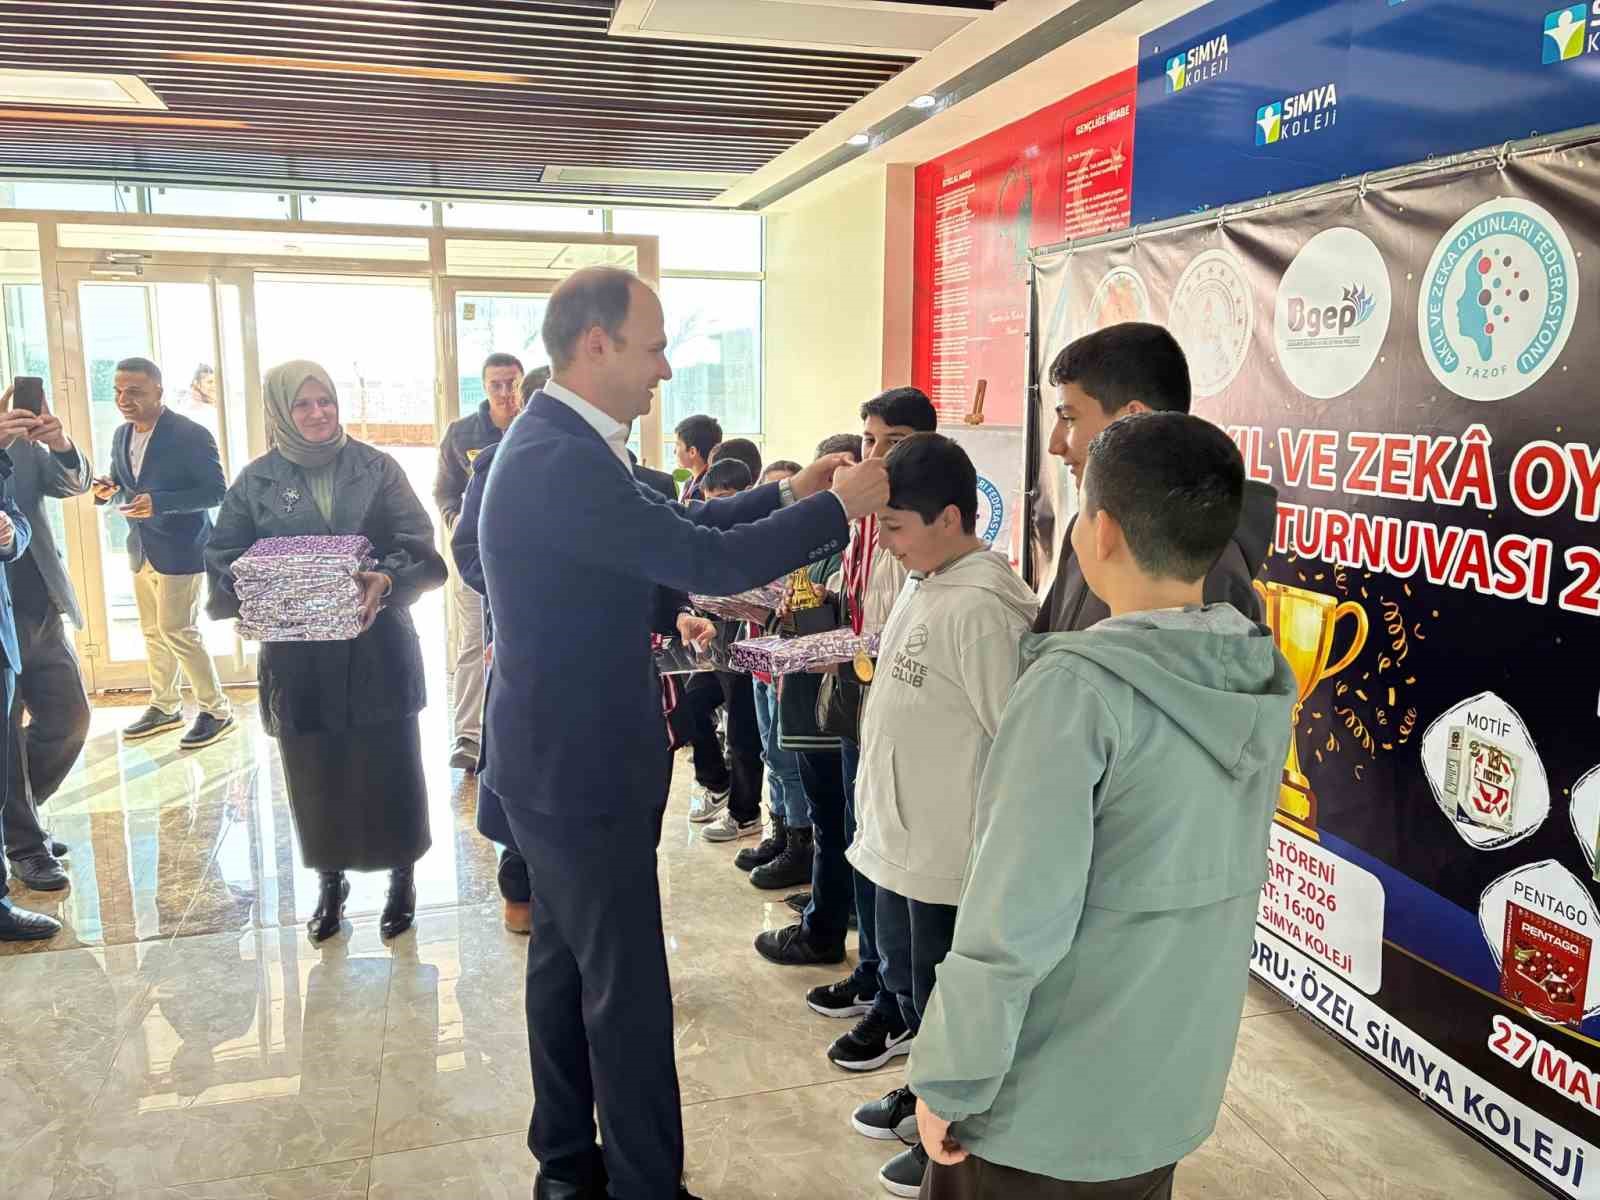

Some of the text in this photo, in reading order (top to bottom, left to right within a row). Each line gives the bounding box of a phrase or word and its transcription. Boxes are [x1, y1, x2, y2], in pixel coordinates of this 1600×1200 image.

[1281, 109, 1336, 140] KOLEJİ
[1430, 216, 1564, 369] AKIL VE ZEKA OYUNLARI FEDERASYONU
[1227, 425, 1272, 484] IL
[1278, 427, 1338, 489] VE
[1344, 424, 1498, 509] ZEKÂ
[1275, 502, 1552, 606] TURNUVASI
[891, 666, 924, 688] CLUB
[895, 652, 928, 677] SKATE
[1467, 712, 1511, 737] MOTİF
[1278, 839, 1335, 885] TÖRENİ
[1284, 893, 1325, 931] 16:00
[1297, 876, 1337, 912] 2026
[1514, 881, 1587, 926] PENTAGO
[1263, 905, 1352, 973] SİMYA KOLEJİ
[1521, 922, 1579, 954] PENTAGO
[1301, 967, 1359, 1038] ÖZEL
[1366, 1019, 1455, 1104] SİMYA
[1464, 1086, 1584, 1188] KOLEJİ
[1488, 1015, 1600, 1112] 27 MA
